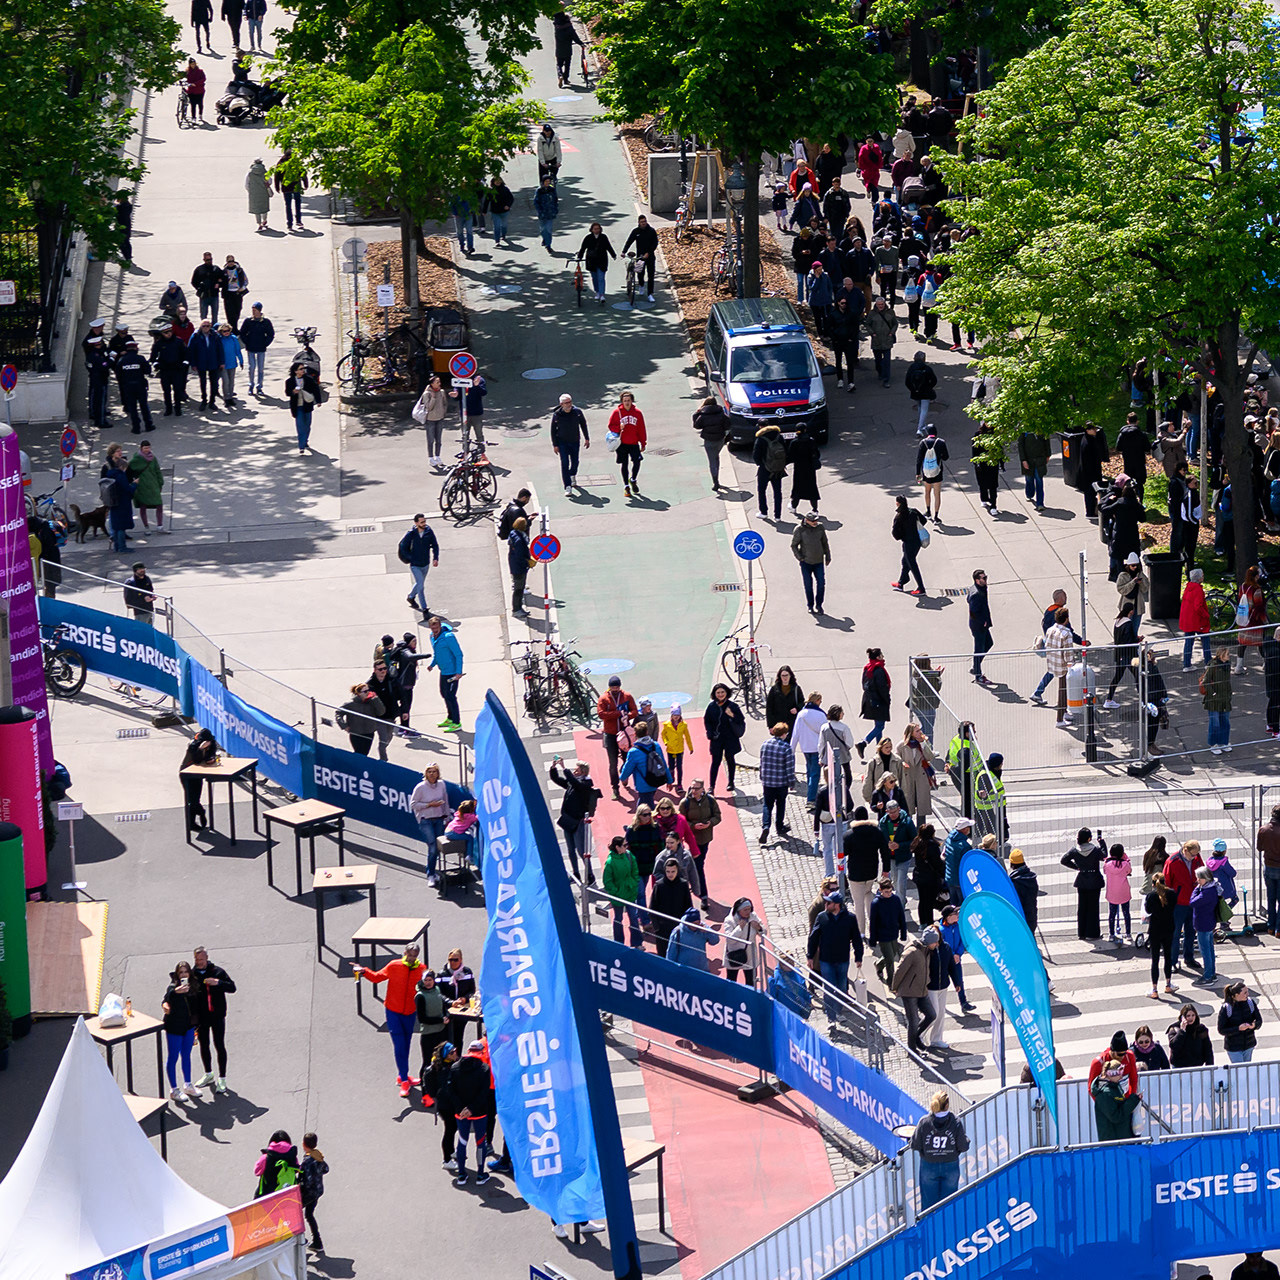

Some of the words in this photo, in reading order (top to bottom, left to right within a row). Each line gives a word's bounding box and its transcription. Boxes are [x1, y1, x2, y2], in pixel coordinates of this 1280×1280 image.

[755, 388, 801, 398] POLIZEI
[220, 709, 277, 757] SPARKASSE
[313, 764, 358, 796] ERSTE
[633, 975, 734, 1030] SPARKASSE
[788, 1038, 820, 1084] ERSTE
[932, 1136, 948, 1149] 97
[1156, 1174, 1229, 1204] ERSTE
[157, 1252, 175, 1265] ERSTE
[182, 1237, 214, 1255] SPARKASSE
[157, 1256, 182, 1271] Running
